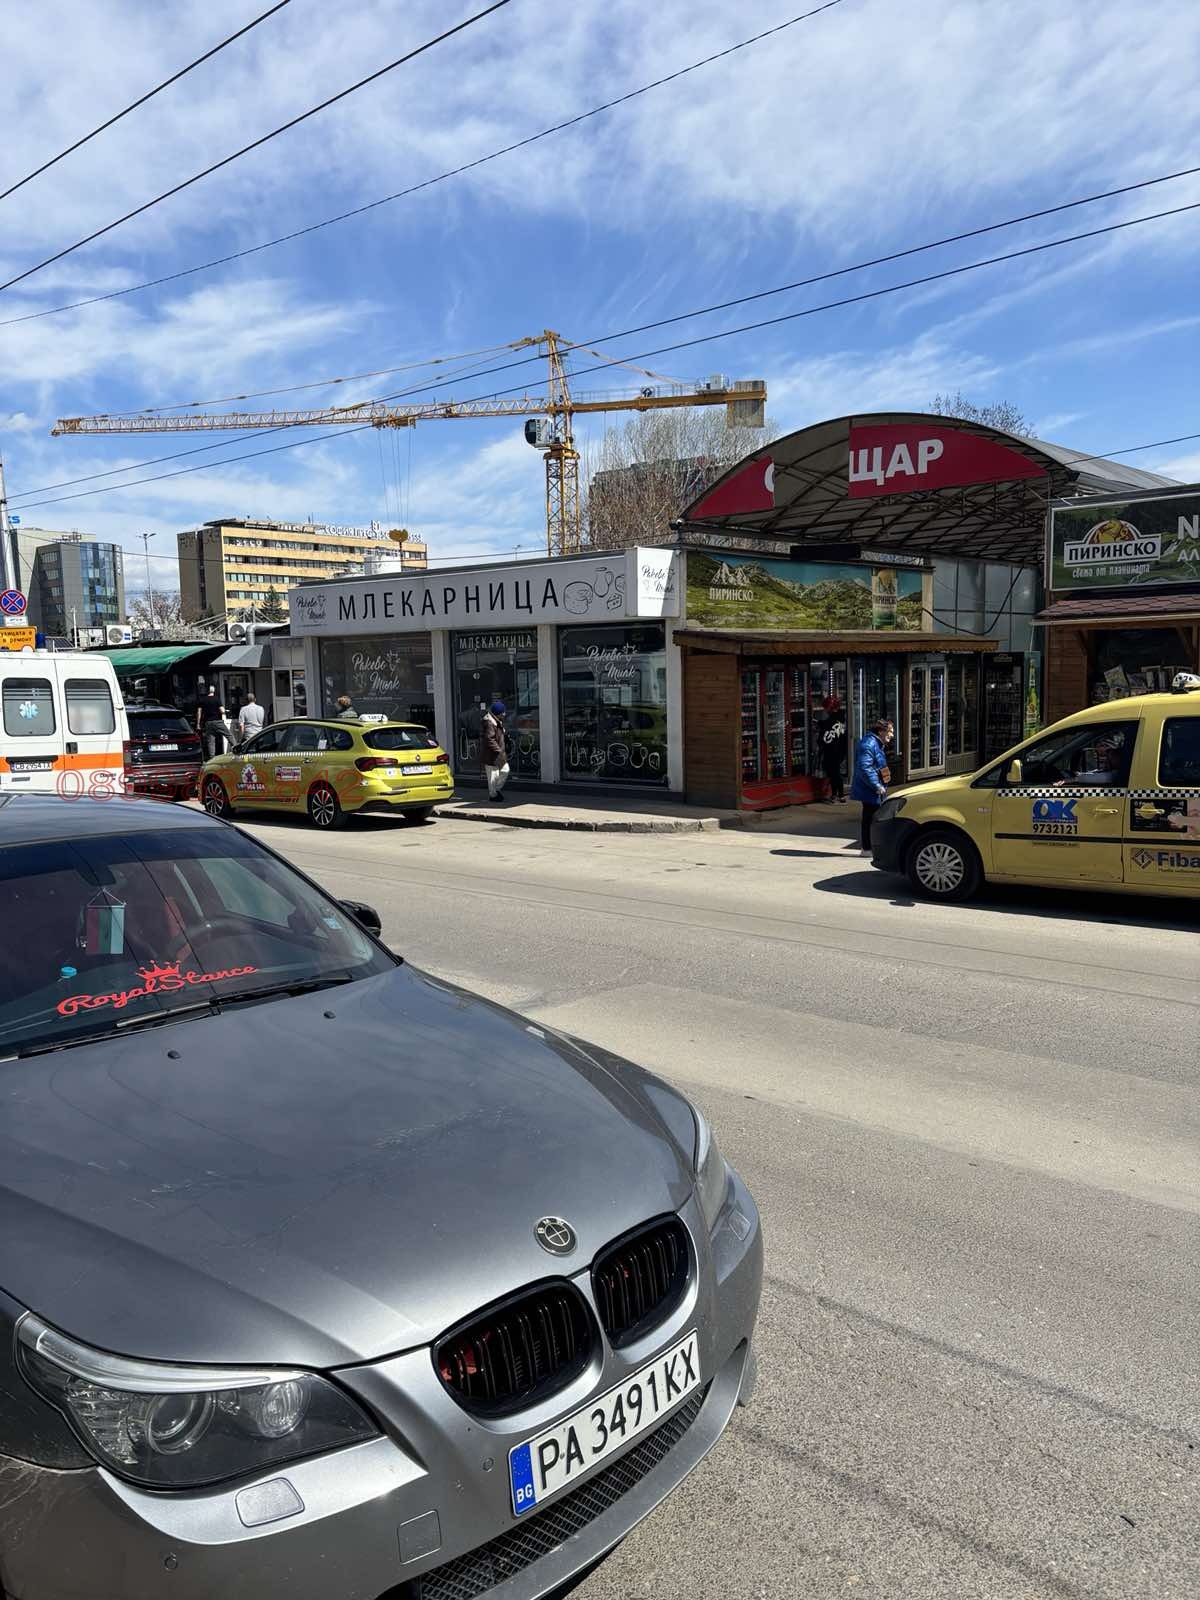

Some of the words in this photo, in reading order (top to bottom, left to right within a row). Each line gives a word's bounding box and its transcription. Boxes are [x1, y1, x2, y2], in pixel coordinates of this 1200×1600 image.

[1068, 541, 1157, 561] ПИРИНСКО
[338, 577, 559, 621] МЛЕКАРНИЦА
[709, 586, 754, 601] ПИРИНСКО
[459, 633, 533, 650] МЛЕКАРНИЦА
[1033, 823, 1078, 835] 9732121
[538, 1425, 584, 1490] PA
[591, 1370, 659, 1455] 3491
[664, 1341, 697, 1402] KX
[516, 1483, 534, 1504] BG
